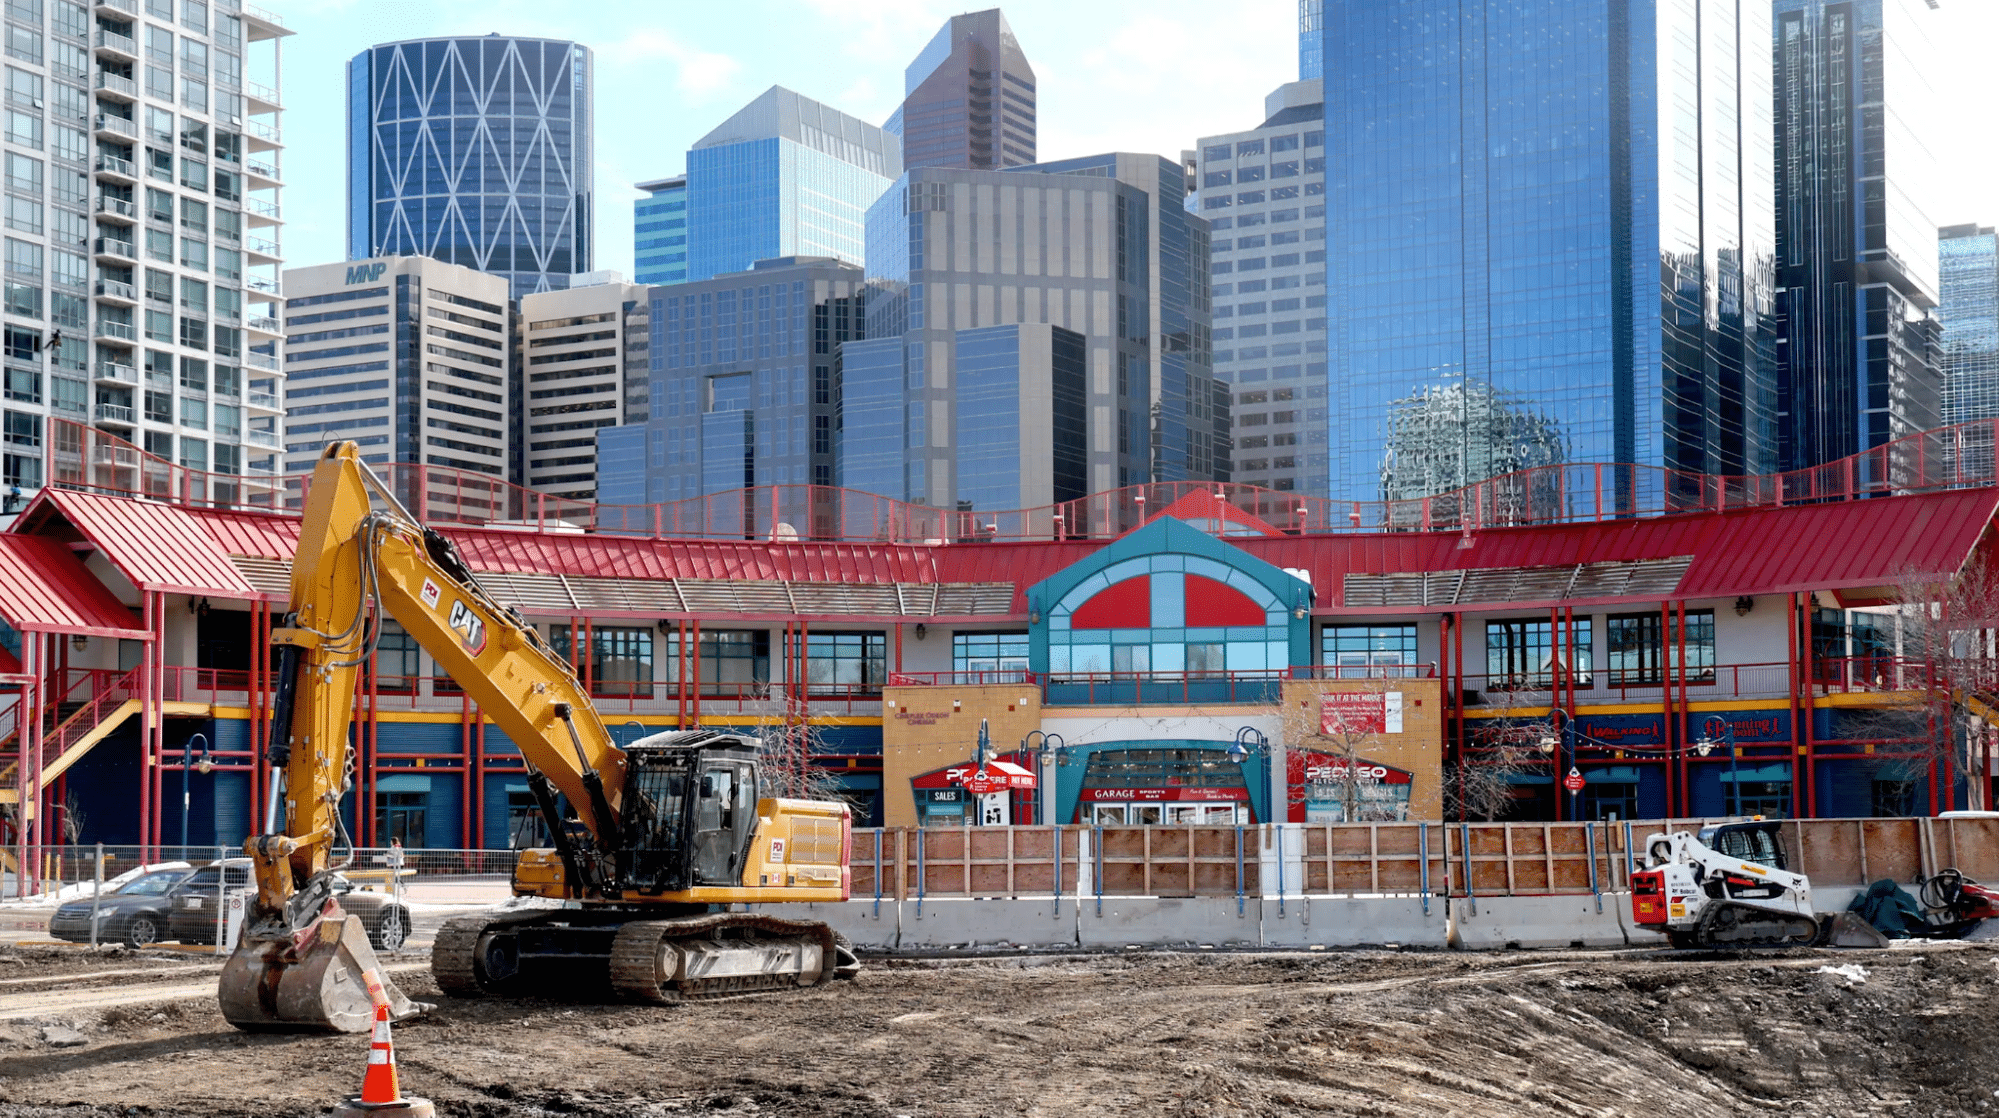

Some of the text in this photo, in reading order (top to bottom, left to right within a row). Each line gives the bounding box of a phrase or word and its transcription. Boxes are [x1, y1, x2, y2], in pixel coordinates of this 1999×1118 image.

[345, 262, 387, 286] MNP
[449, 600, 483, 645] CAT
[1593, 727, 1651, 737] WALKING
[934, 791, 956, 801] SALES
[1095, 789, 1135, 798] GARAGE
[773, 842, 783, 852] PDI
